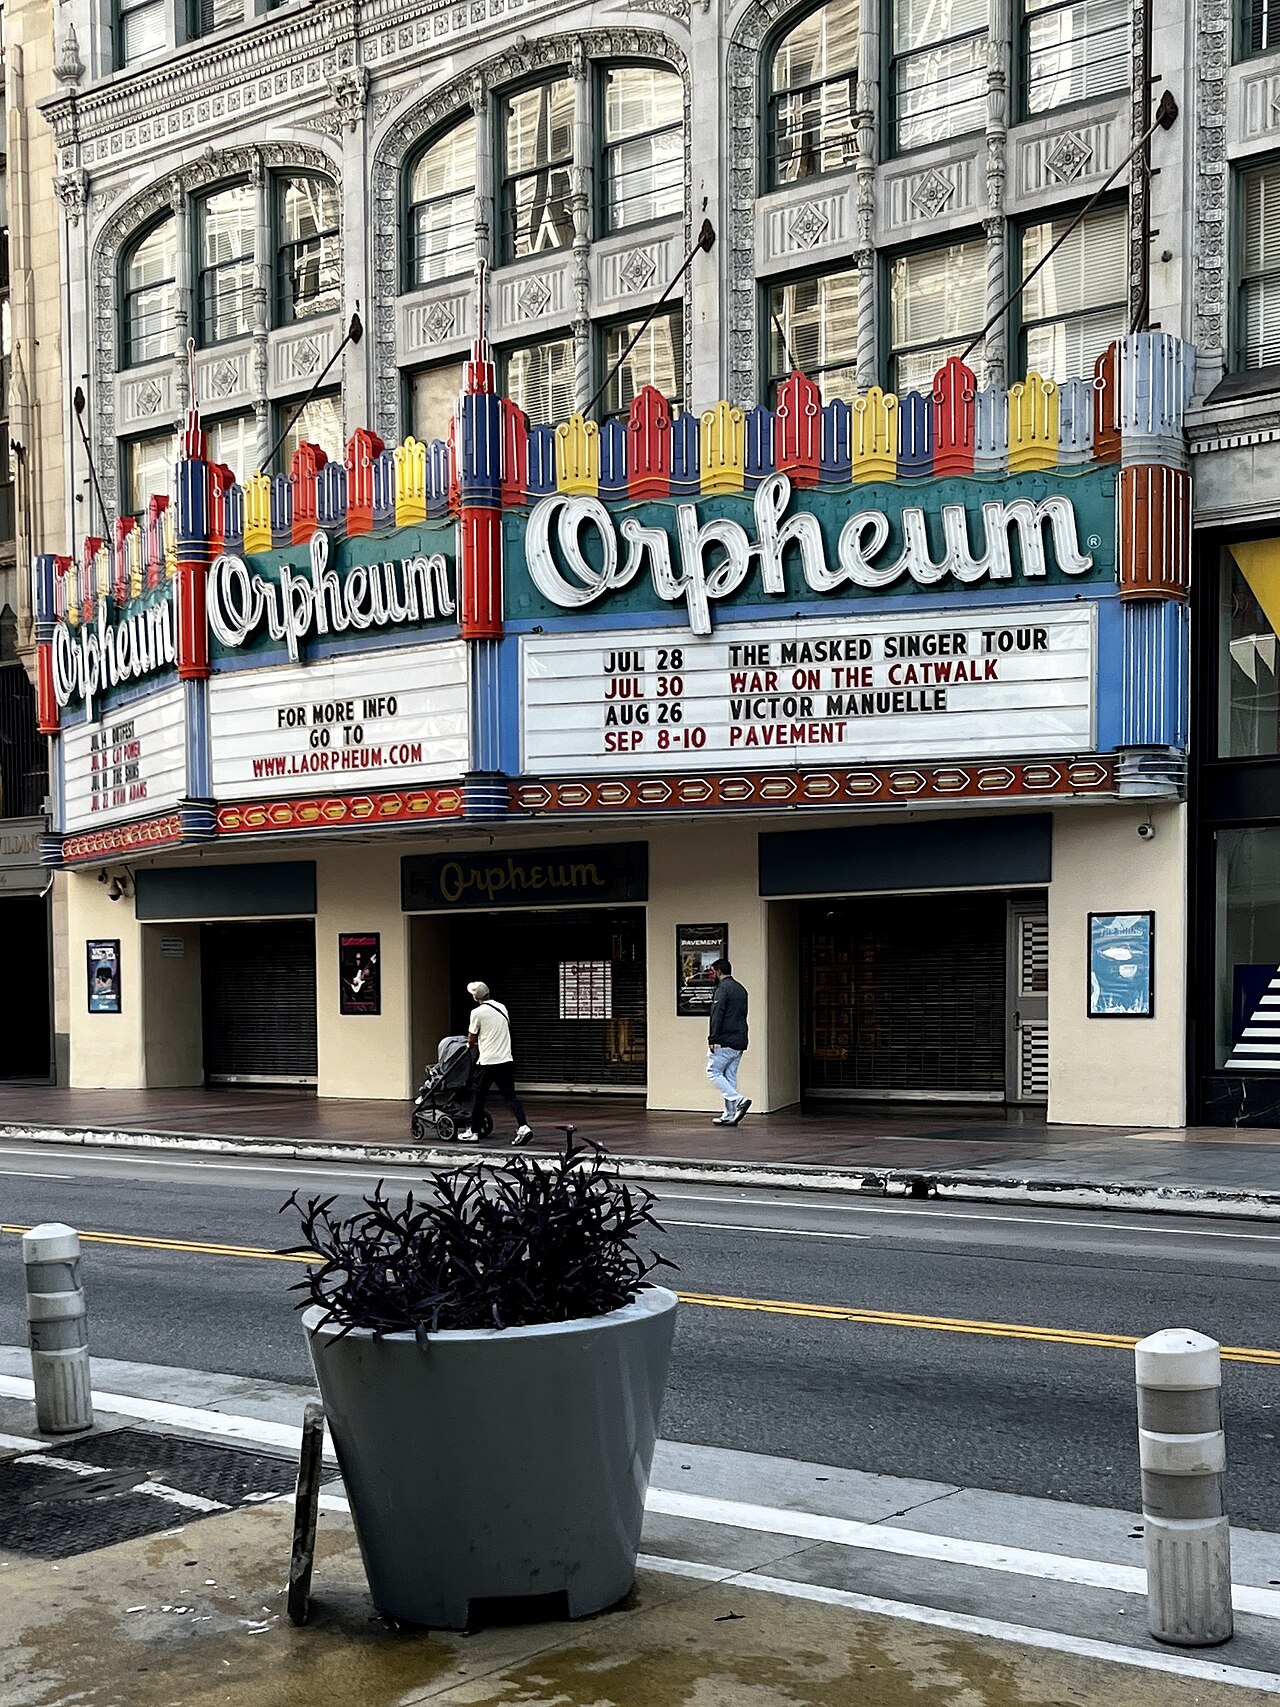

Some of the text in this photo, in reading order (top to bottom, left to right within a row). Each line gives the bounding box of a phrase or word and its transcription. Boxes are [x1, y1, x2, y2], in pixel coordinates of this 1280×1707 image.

[525, 475, 1092, 635] Orpheum
[207, 529, 456, 663] Orpheum
[52, 593, 178, 723] Orpheum
[604, 628, 1048, 673] JUL 28 THE MASKED SINGER TOUR
[604, 658, 999, 699] JUL 30 WAR ON THE CATWALK
[278, 696, 398, 728] FOR MORE INFO
[605, 689, 948, 726] AUG 26 VICTOR MANUELLE
[309, 724, 364, 748] GO TO
[604, 722, 848, 752] SEP 8-10 PAVEMENT
[252, 743, 423, 778] WWW.LAORPHEUM.COM
[439, 858, 605, 902] Orpheum
